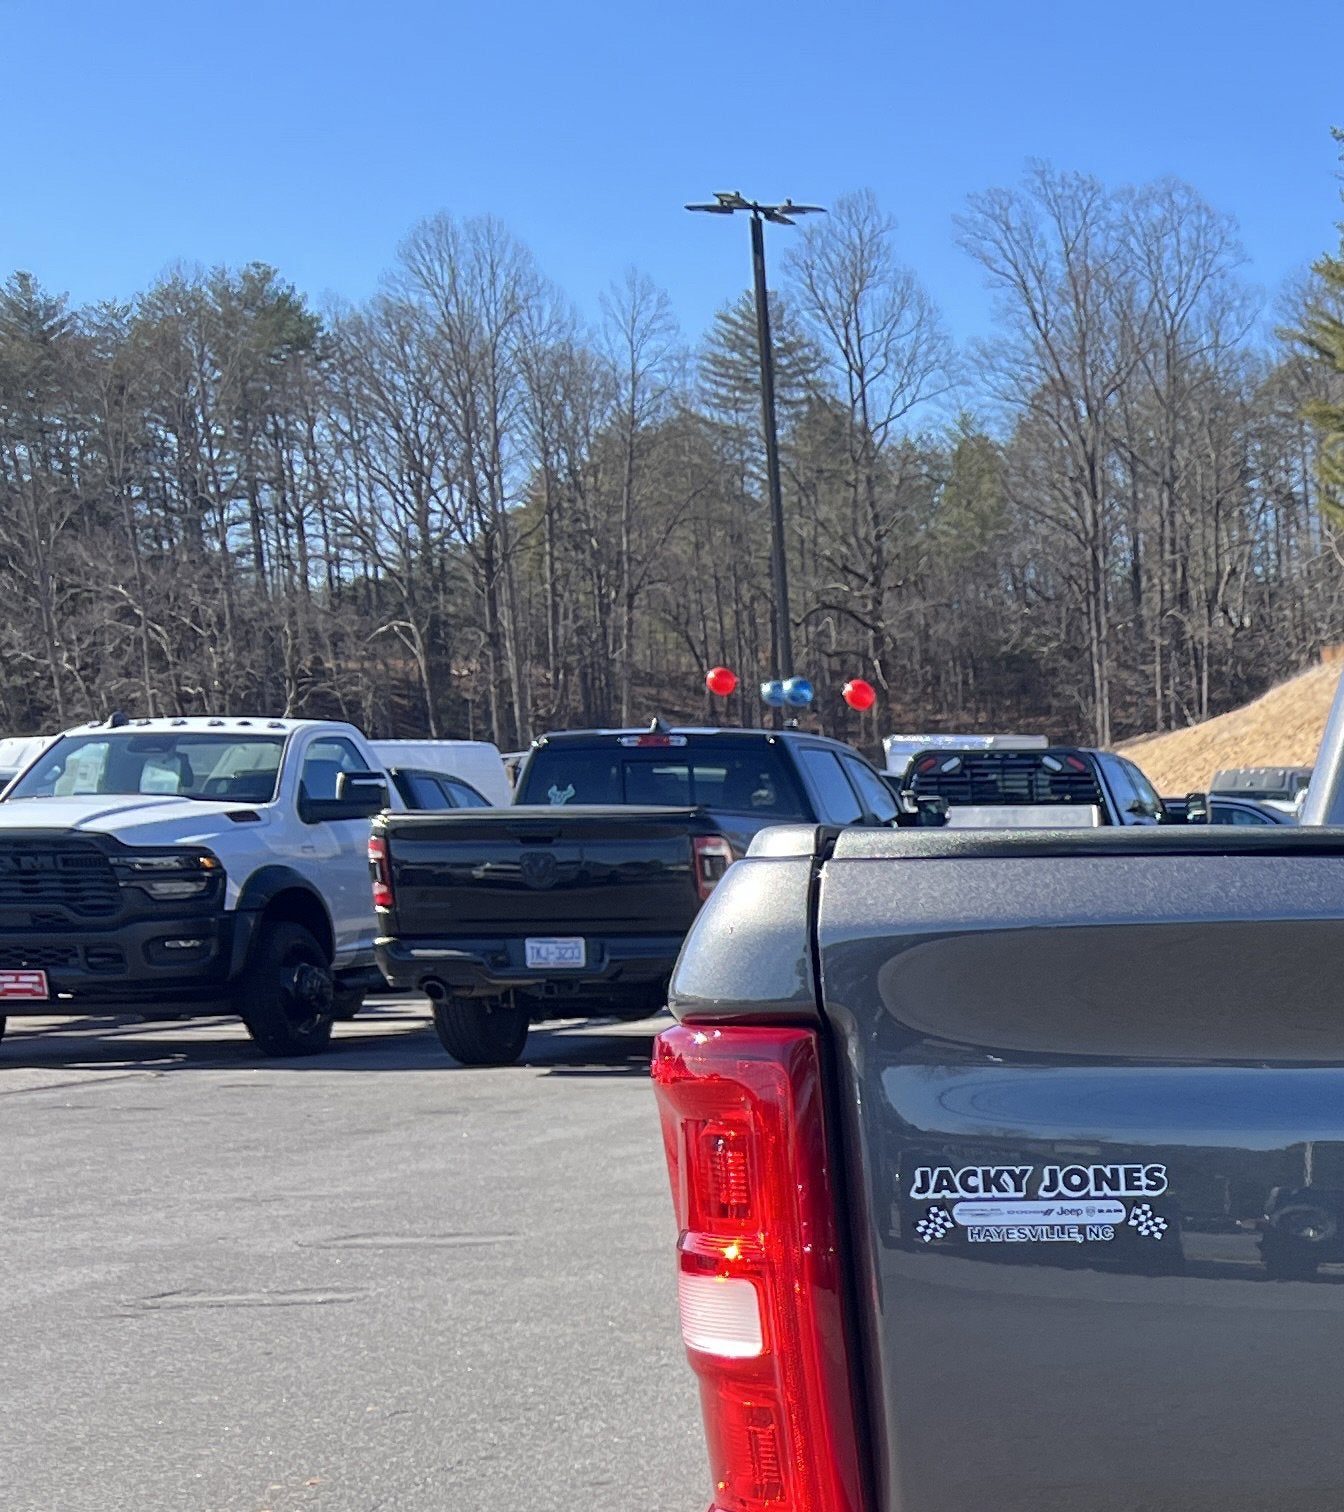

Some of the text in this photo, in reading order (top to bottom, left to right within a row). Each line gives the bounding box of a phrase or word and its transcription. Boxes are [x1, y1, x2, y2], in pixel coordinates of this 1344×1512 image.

[910, 1164, 1168, 1198] JACKY JONES
[1057, 1206, 1083, 1217] Jeep
[967, 1225, 1115, 1243] HAYESVILLE, NC
